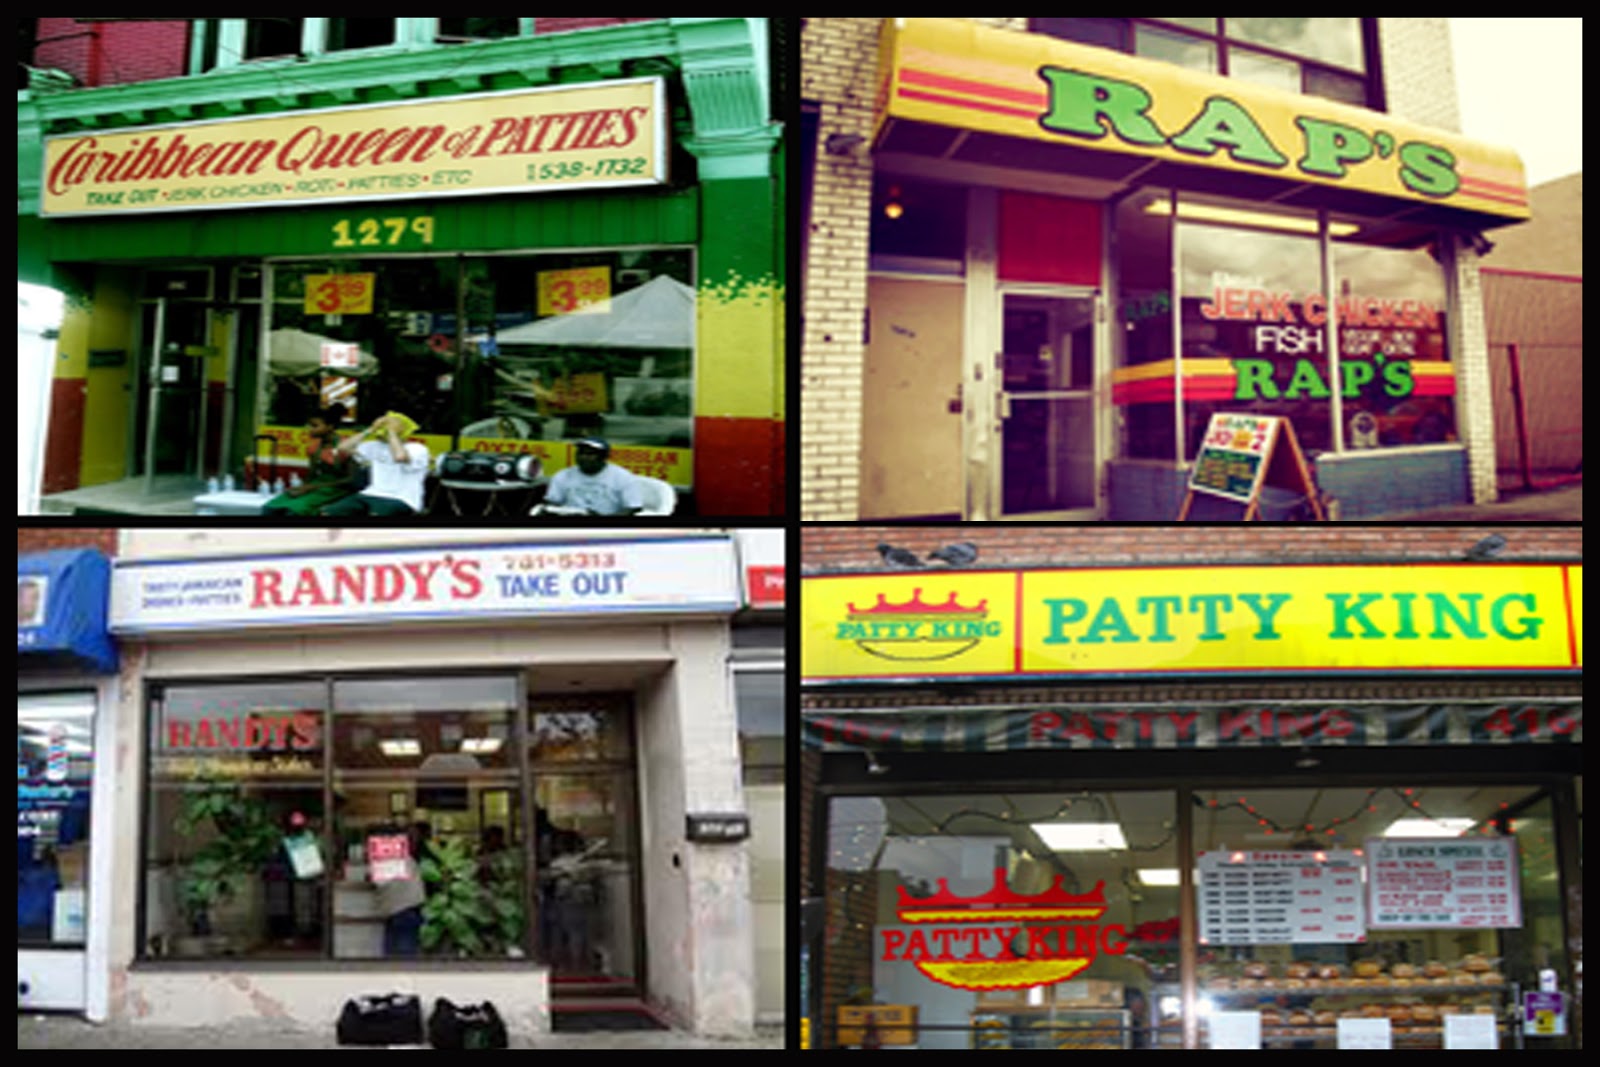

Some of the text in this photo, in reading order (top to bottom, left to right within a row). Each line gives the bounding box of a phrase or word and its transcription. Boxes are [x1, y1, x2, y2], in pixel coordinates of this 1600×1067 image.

[48, 136, 277, 196] Caribbean
[276, 125, 446, 175] Queen
[470, 106, 650, 158] PATTIES
[1037, 64, 1461, 198] RAP'S
[331, 216, 435, 247] 1279
[1200, 286, 1298, 322] JERK
[1302, 295, 1438, 329] CHICKEN
[1256, 326, 1323, 354] FISH
[1231, 352, 1414, 400] RAP'S
[250, 553, 483, 609] RANDY'S
[496, 571, 628, 598] TAKE OUT
[835, 620, 1002, 640] PATTY KING
[1042, 592, 1545, 645] PATTY KING
[1030, 711, 1202, 741] PATTY
[1218, 709, 1355, 738] KING
[880, 924, 1130, 961] PATTY KING
